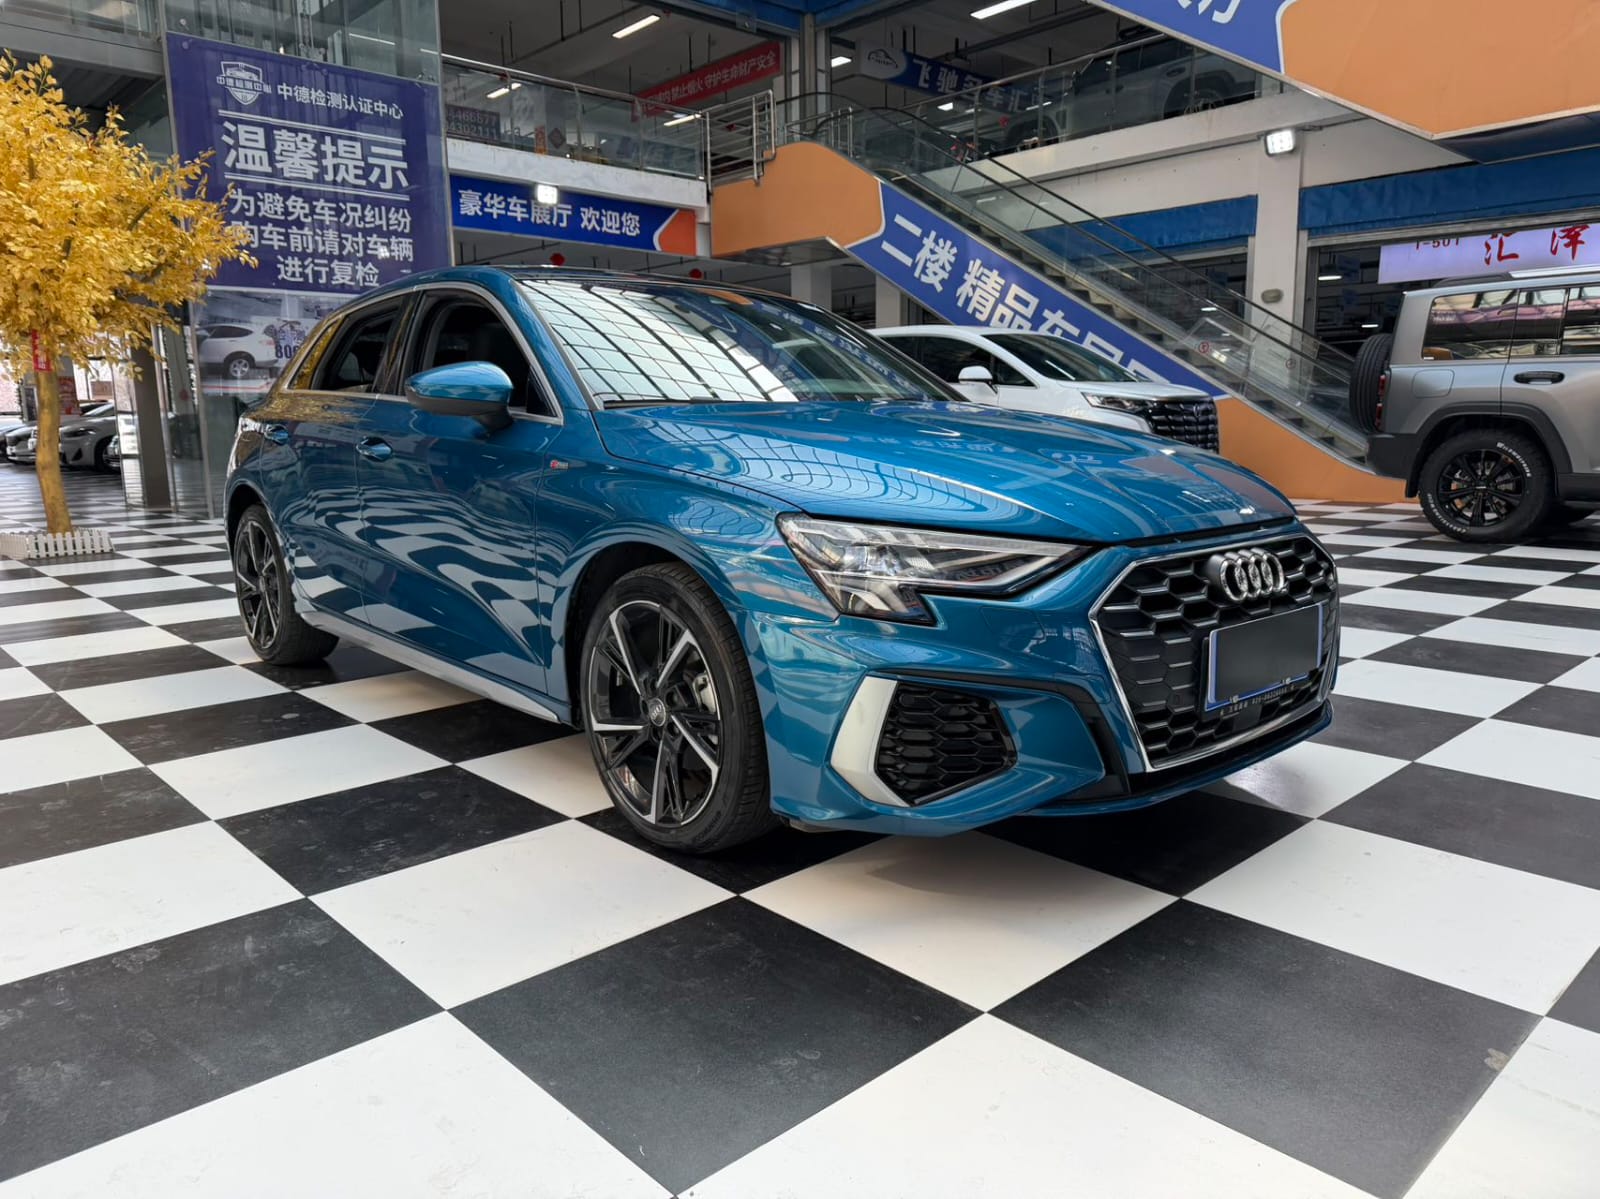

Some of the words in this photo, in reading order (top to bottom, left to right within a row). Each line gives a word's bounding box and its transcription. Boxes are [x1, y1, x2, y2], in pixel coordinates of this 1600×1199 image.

[277, 83, 404, 120] 中德检测认证中心
[221, 121, 408, 190] 温馨提示
[230, 188, 412, 234] 为避免车况纠纷
[458, 189, 573, 228] 豪华车展厅
[580, 206, 641, 237] 欢迎您
[231, 220, 414, 262] 购车前请对车辆
[881, 213, 958, 293] 二楼
[276, 255, 380, 287] 进行复检
